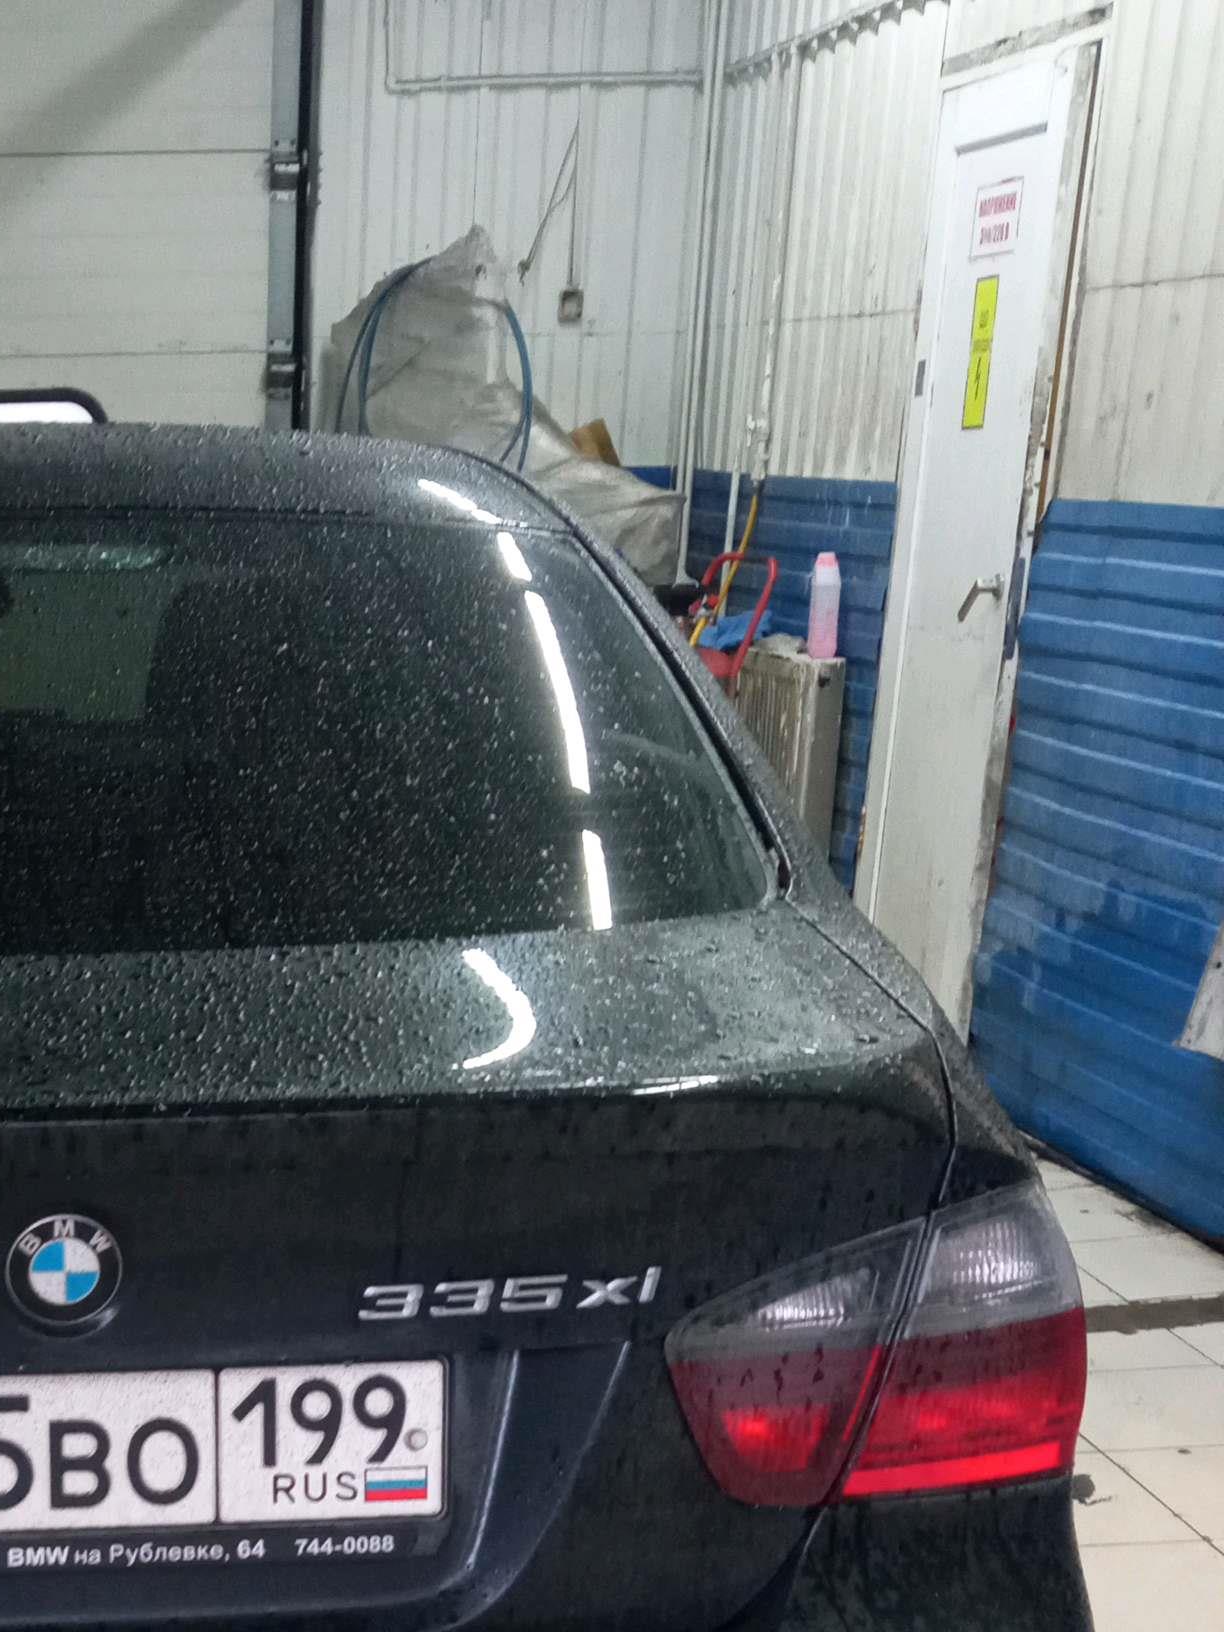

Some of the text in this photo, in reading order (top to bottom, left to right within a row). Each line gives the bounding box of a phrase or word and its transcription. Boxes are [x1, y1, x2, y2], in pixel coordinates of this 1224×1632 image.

[18, 1218, 113, 1256] BMW
[231, 1374, 408, 1468] 199
[272, 1471, 359, 1503] RUS
[7, 1546, 69, 1568] BMW
[74, 1548, 101, 1566] на
[237, 1538, 266, 1559] 64
[295, 1535, 395, 1556] 744-0088
